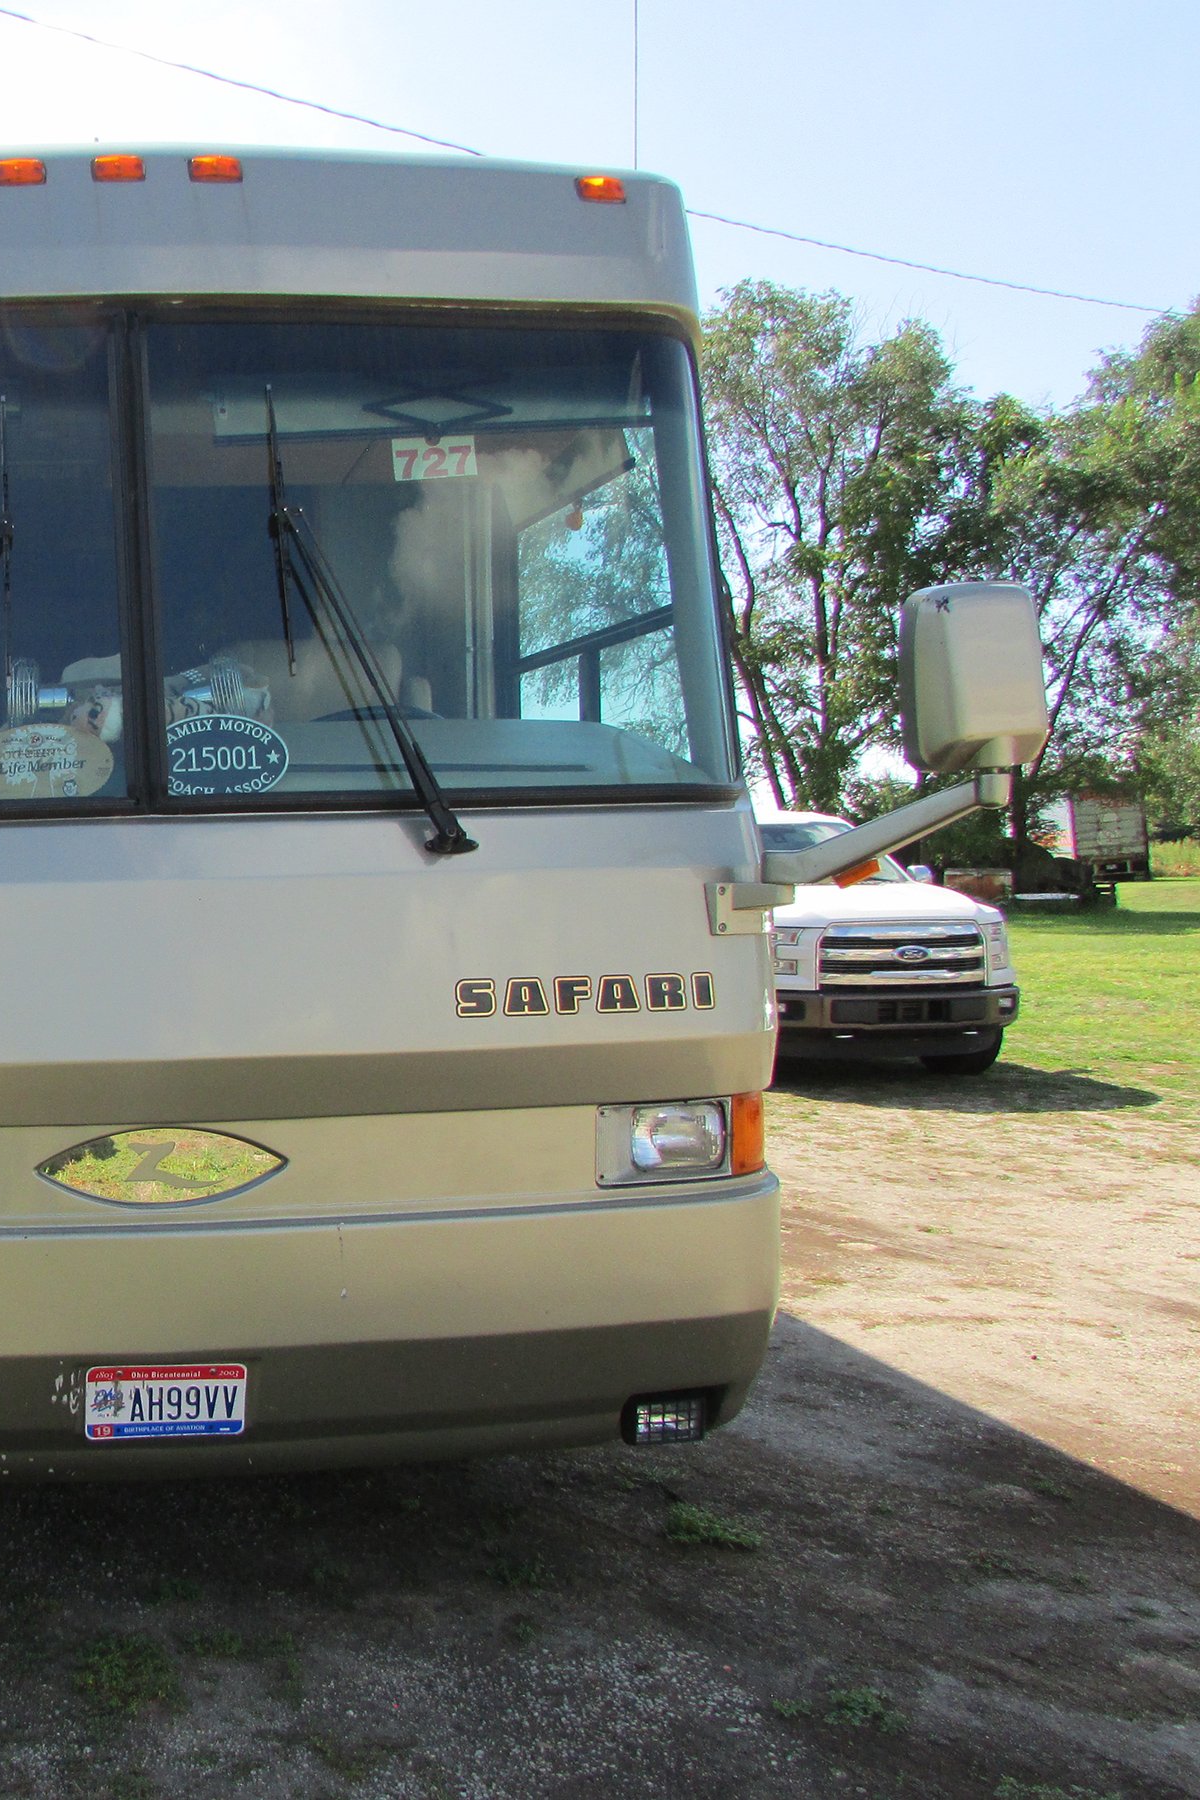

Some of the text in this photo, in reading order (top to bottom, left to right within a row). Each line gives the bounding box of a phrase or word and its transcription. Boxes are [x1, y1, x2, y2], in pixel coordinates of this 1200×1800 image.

[395, 445, 471, 479] 727
[167, 719, 272, 746] AMILY MOTOR
[27, 758, 87, 773] Member
[171, 745, 261, 772] 215001
[455, 972, 716, 1018] SAFARI
[131, 1371, 149, 1379] Ohio
[151, 1371, 201, 1379] Bicentennial
[219, 1370, 240, 1378] 2003
[130, 1385, 238, 1422] AH99VV
[94, 1425, 111, 1436] 19
[124, 1425, 163, 1433] BIRTHPLACE
